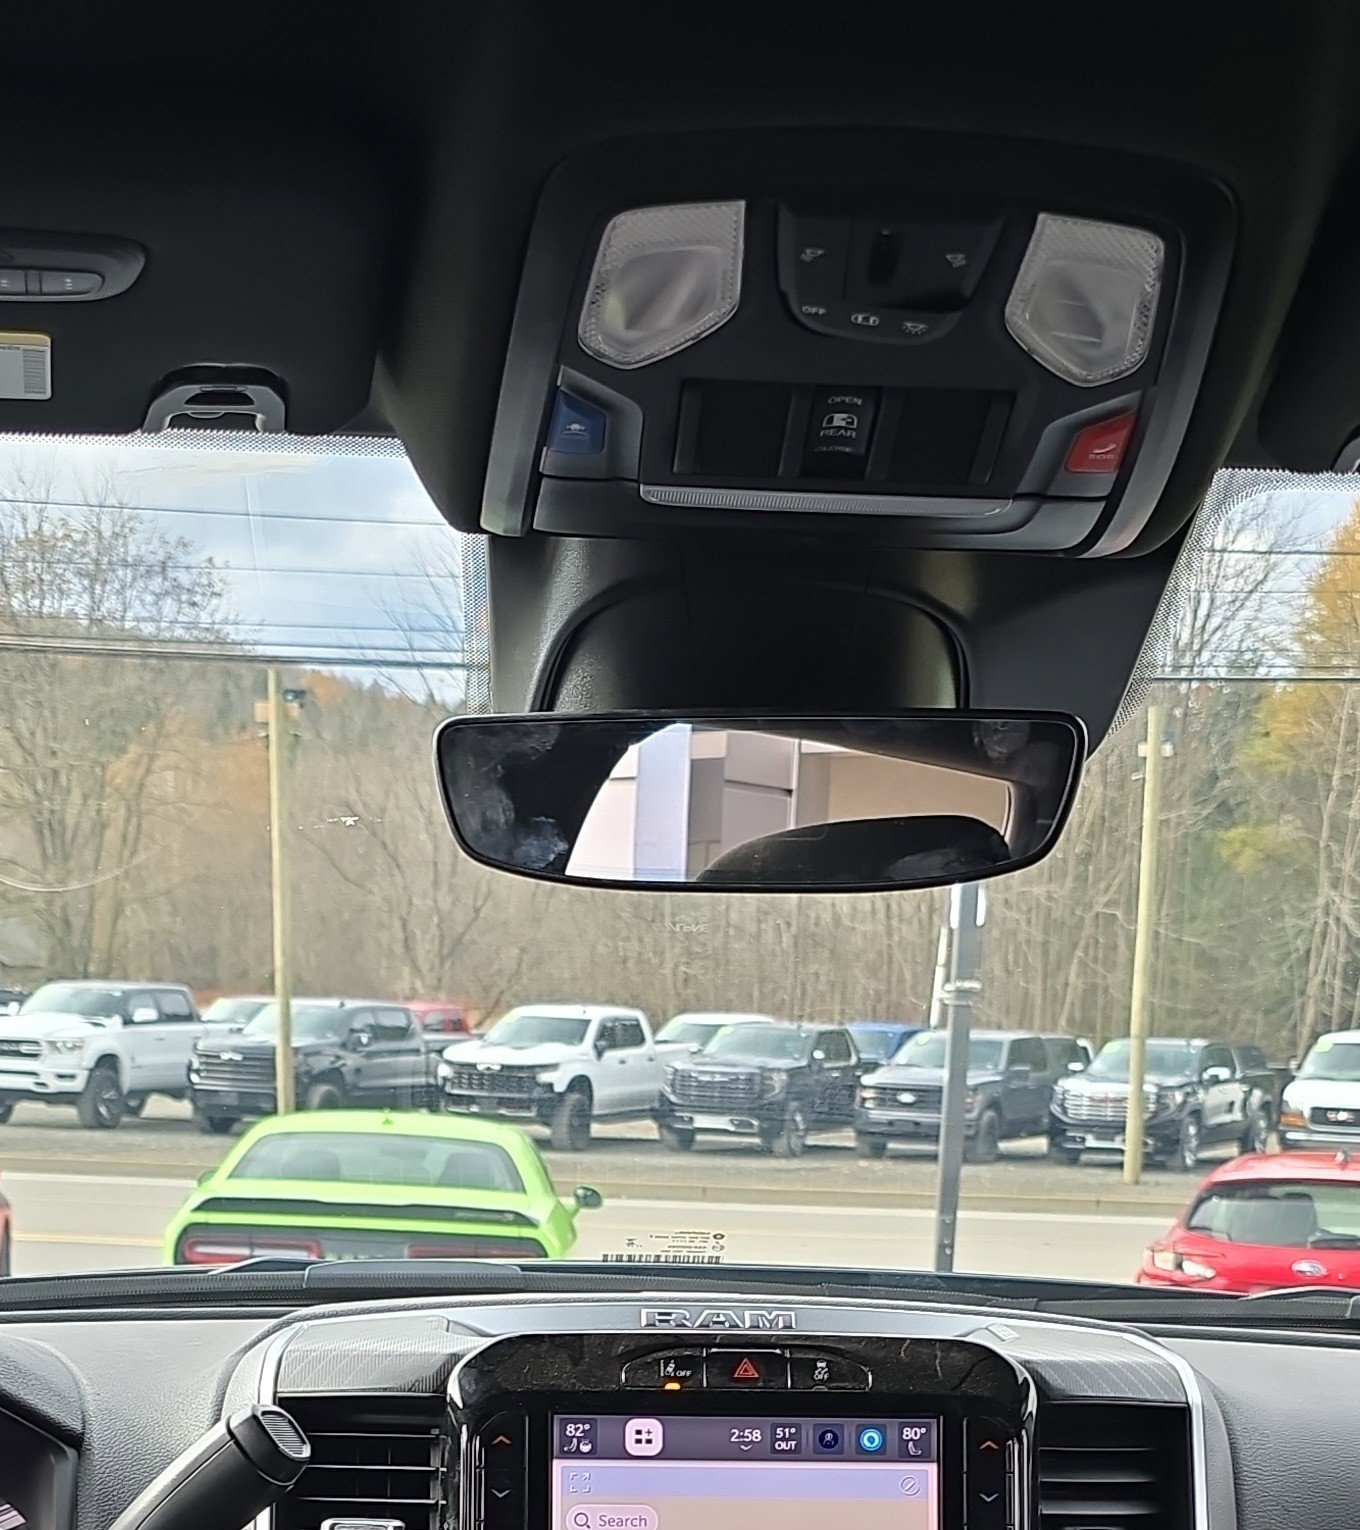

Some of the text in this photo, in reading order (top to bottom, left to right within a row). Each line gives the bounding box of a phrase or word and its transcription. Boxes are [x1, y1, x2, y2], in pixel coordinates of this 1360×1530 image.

[820, 428, 856, 439] REAR
[640, 1308, 797, 1330] RAM
[565, 1422, 591, 1437] 82°
[729, 1428, 763, 1443] 2:58
[774, 1427, 797, 1440] 51°
[901, 1426, 928, 1441] 80°
[774, 1440, 798, 1452] OUT
[597, 1513, 649, 1529] Search
